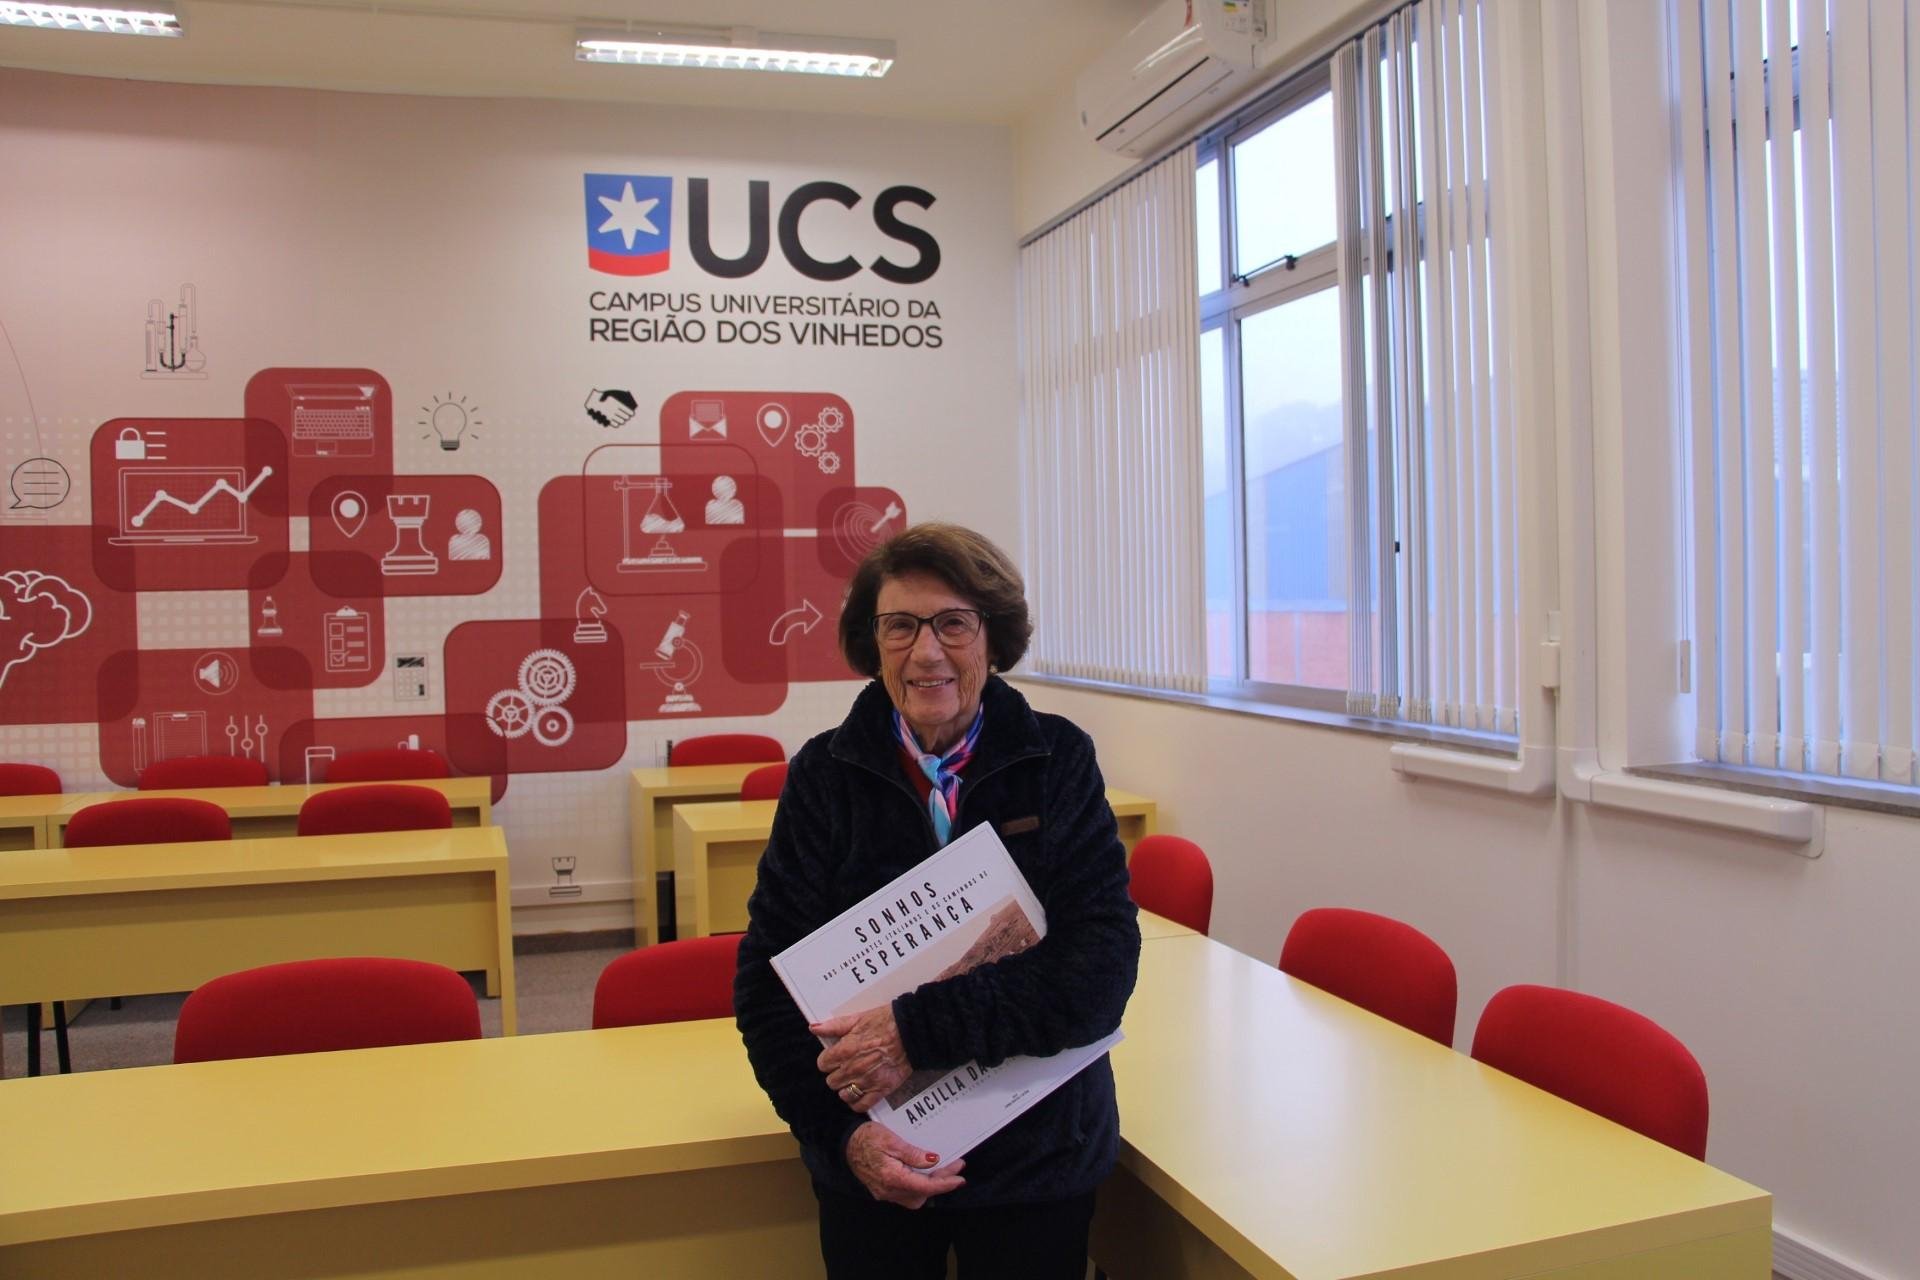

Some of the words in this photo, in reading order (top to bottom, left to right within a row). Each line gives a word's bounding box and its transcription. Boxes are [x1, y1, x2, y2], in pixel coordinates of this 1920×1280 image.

[688, 177, 941, 285] UCS
[589, 291, 701, 313] CAMPUS
[711, 293, 899, 318] UNIVERSITÁRIO
[908, 300, 941, 319] DA
[590, 315, 706, 343] REGIÃO
[717, 321, 781, 344] DOS
[790, 323, 943, 348] VINHEDOS
[851, 896, 974, 984] ESPERANÇA
[855, 882, 937, 943] SONHOS
[905, 1075, 966, 1124] ANCILLA
